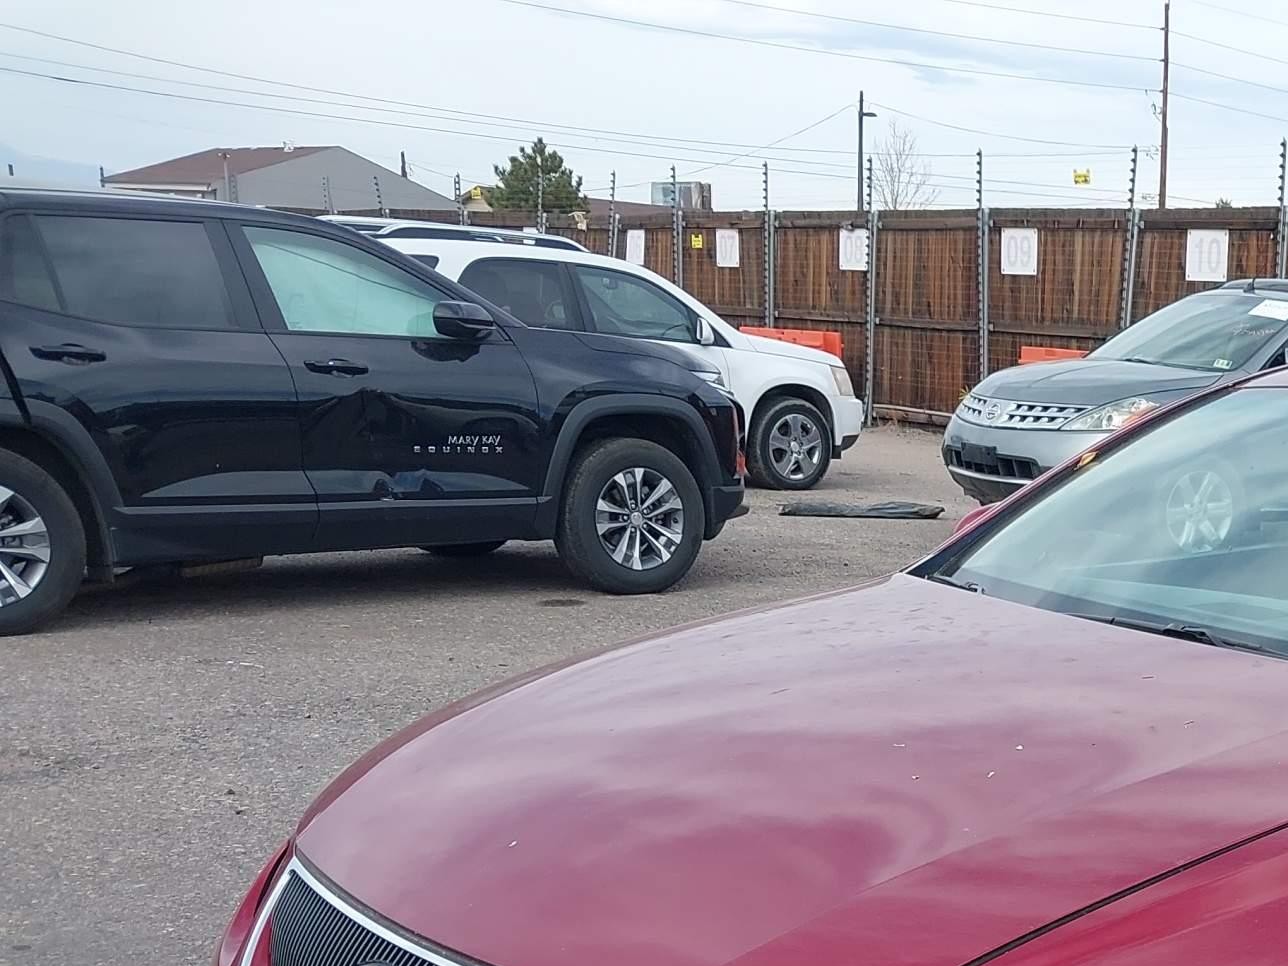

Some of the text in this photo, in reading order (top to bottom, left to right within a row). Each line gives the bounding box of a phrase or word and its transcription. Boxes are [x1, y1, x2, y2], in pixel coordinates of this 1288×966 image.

[1007, 235, 1031, 267] 09
[1194, 238, 1221, 273] 10
[413, 445, 504, 454] EQUINOX
[448, 434, 501, 446] MARY KAY
